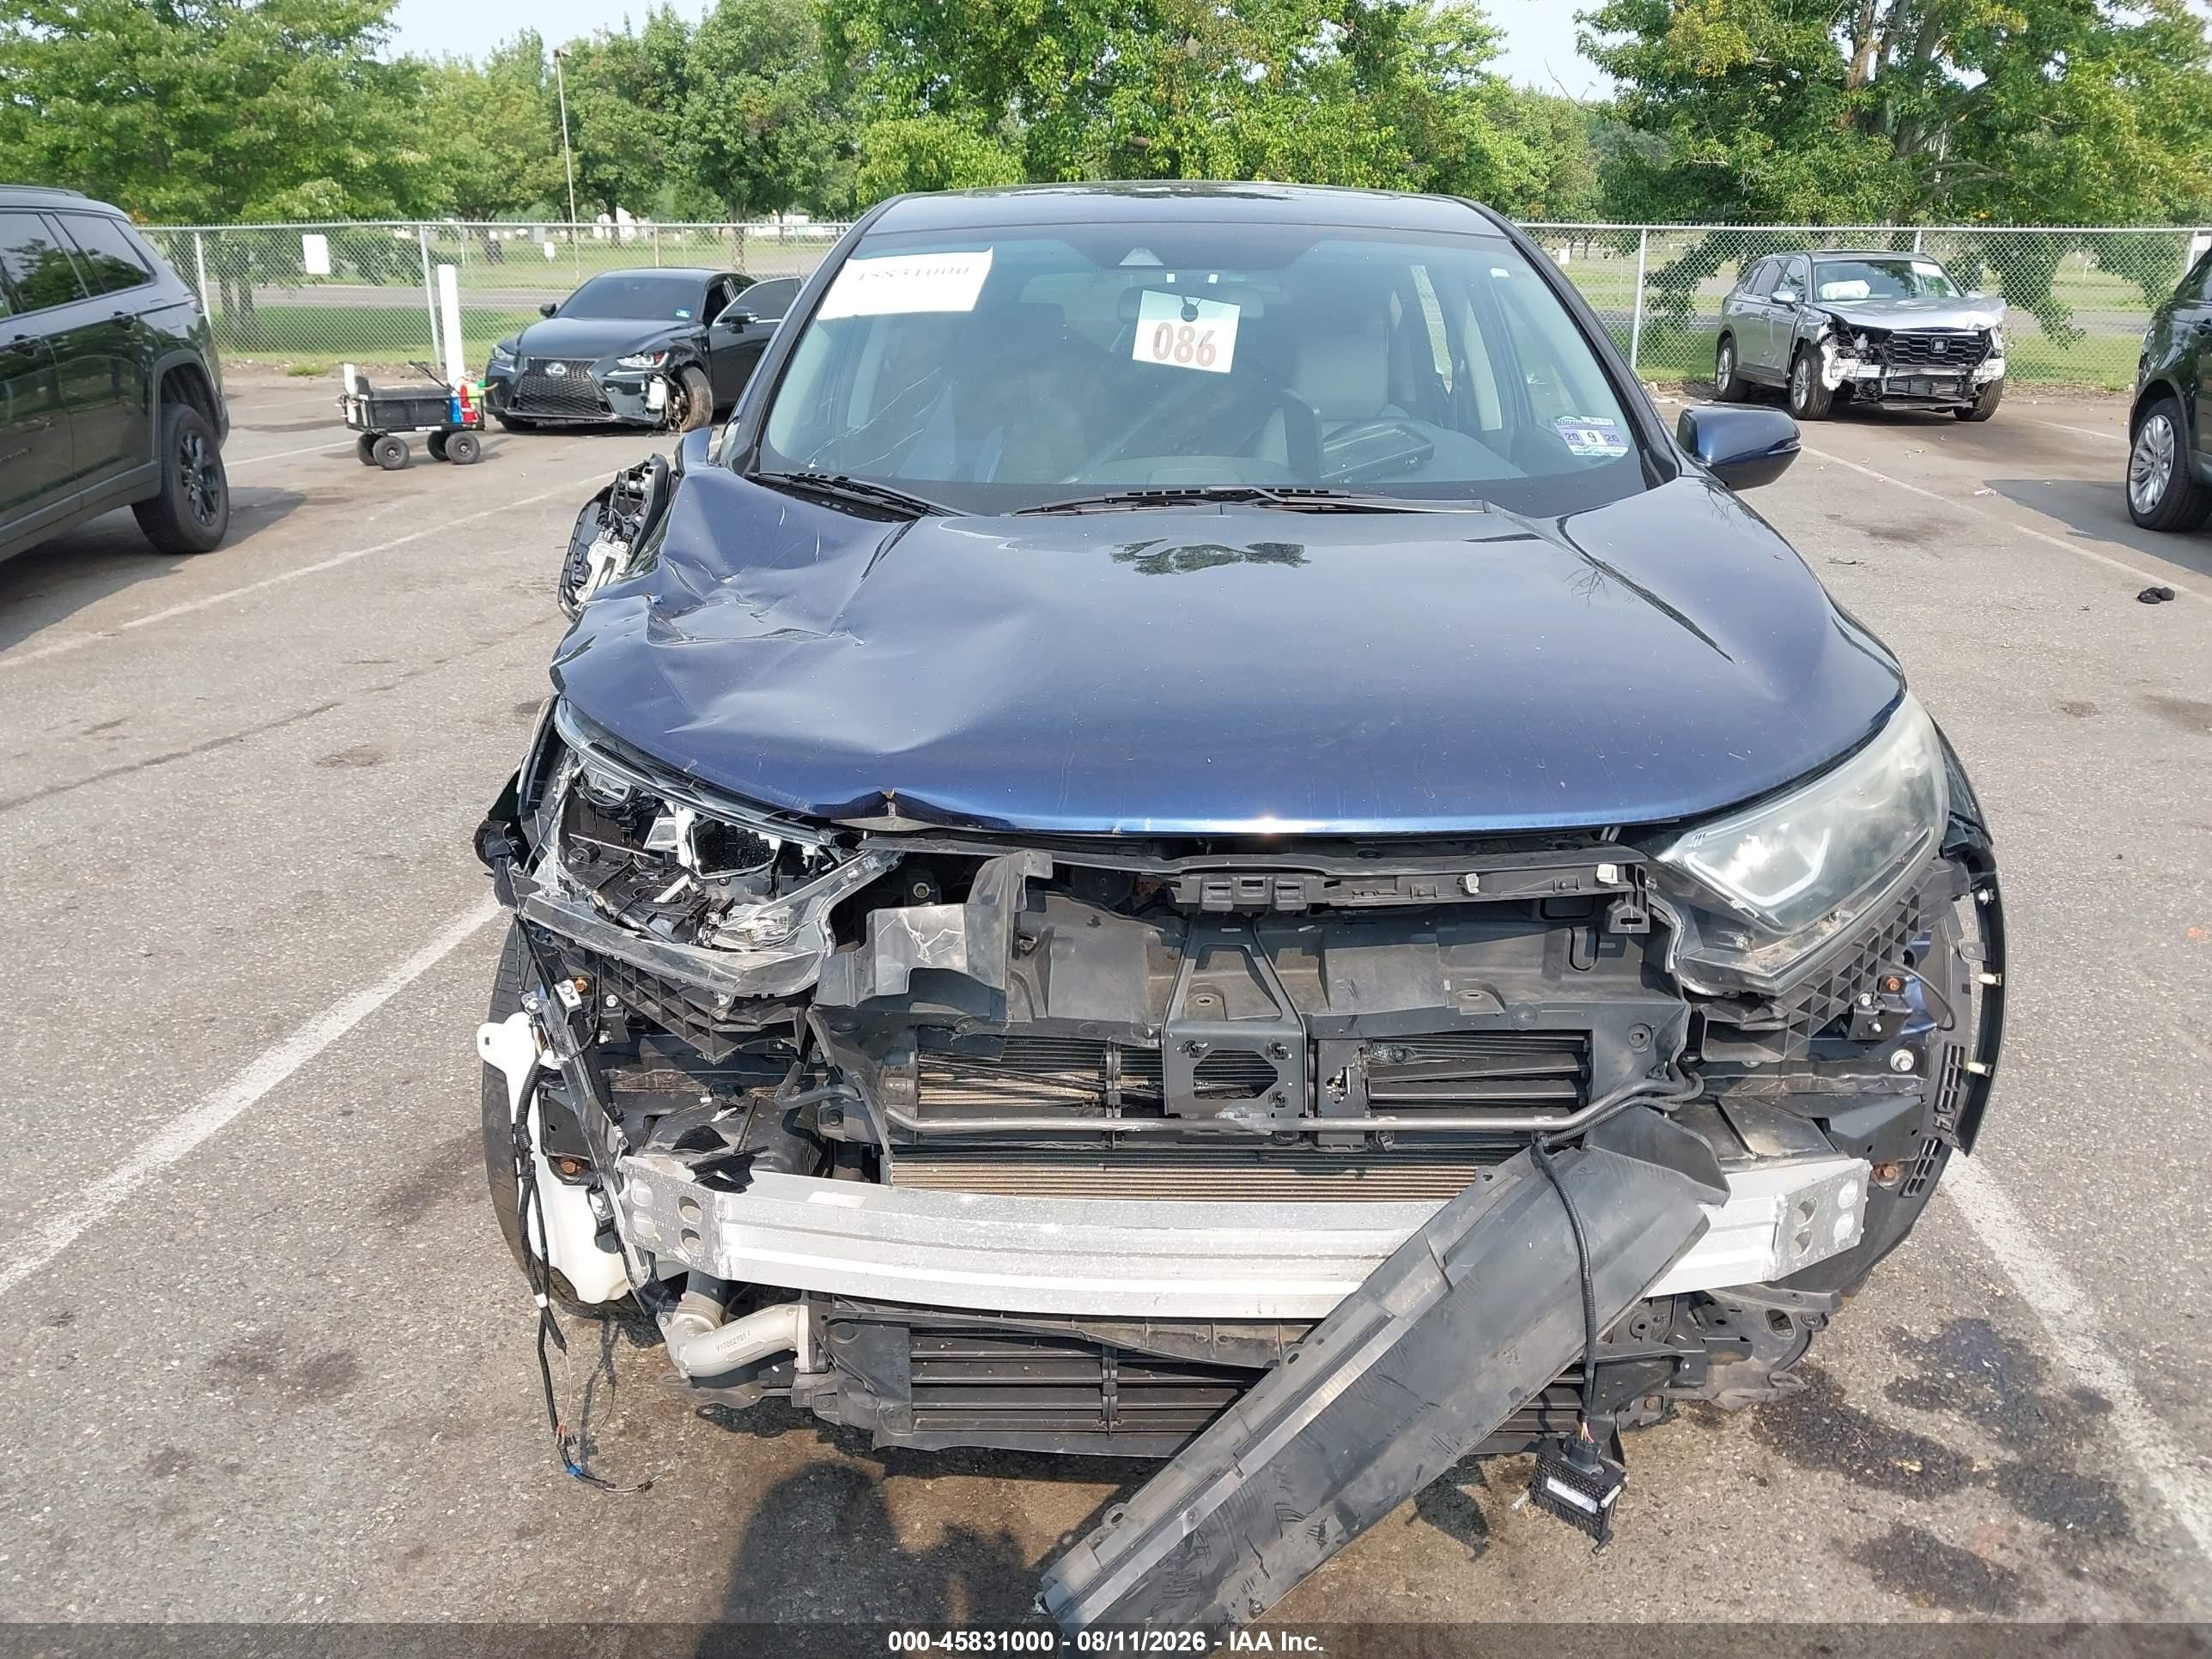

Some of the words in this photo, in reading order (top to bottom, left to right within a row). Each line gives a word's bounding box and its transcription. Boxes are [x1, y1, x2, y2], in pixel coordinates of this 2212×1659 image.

[1152, 322, 1217, 367] 086
[1565, 432, 1580, 441] 20
[1587, 431, 1598, 443] 9
